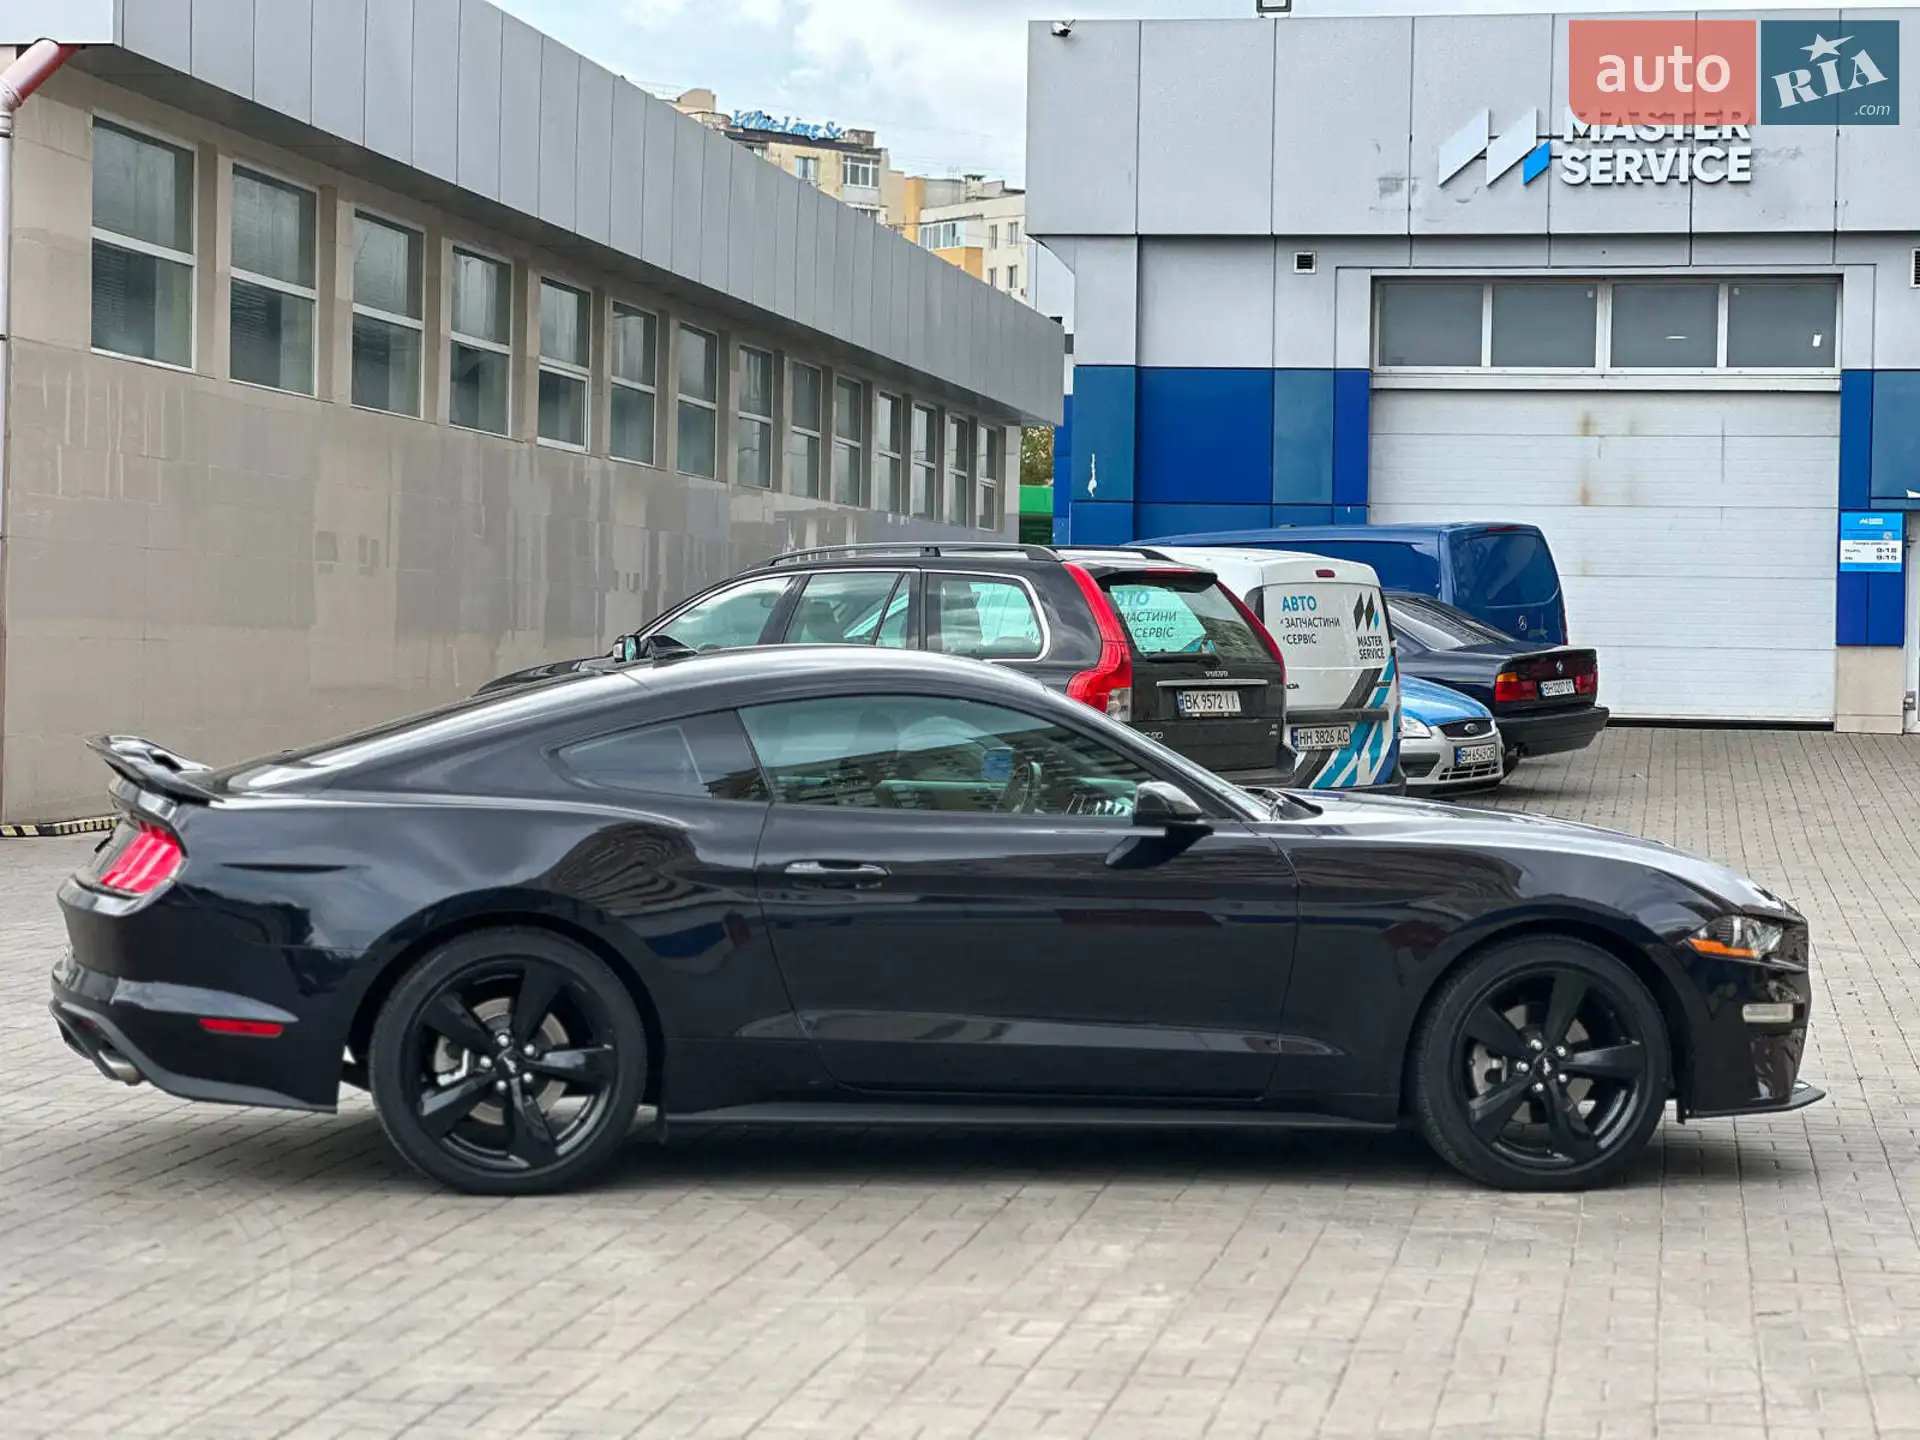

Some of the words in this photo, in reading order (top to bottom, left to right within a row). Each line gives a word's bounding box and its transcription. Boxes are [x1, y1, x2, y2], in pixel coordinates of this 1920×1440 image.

[1563, 106, 1751, 143] MASTER
[1560, 146, 1752, 185] SERVICE
[1282, 596, 1317, 612] АВТО
[1285, 617, 1340, 629] ЗАПЧАСТИНИ
[1134, 627, 1175, 638] СЕРВІС
[1286, 634, 1317, 645] СЕРВІС
[1357, 635, 1383, 648] MASTER
[1359, 648, 1386, 660] SERVICE
[1184, 693, 1201, 710] BK
[1202, 692, 1224, 709] 9572
[1299, 730, 1314, 745] HH
[1314, 730, 1335, 744] 3826
[1337, 728, 1350, 743] AC
